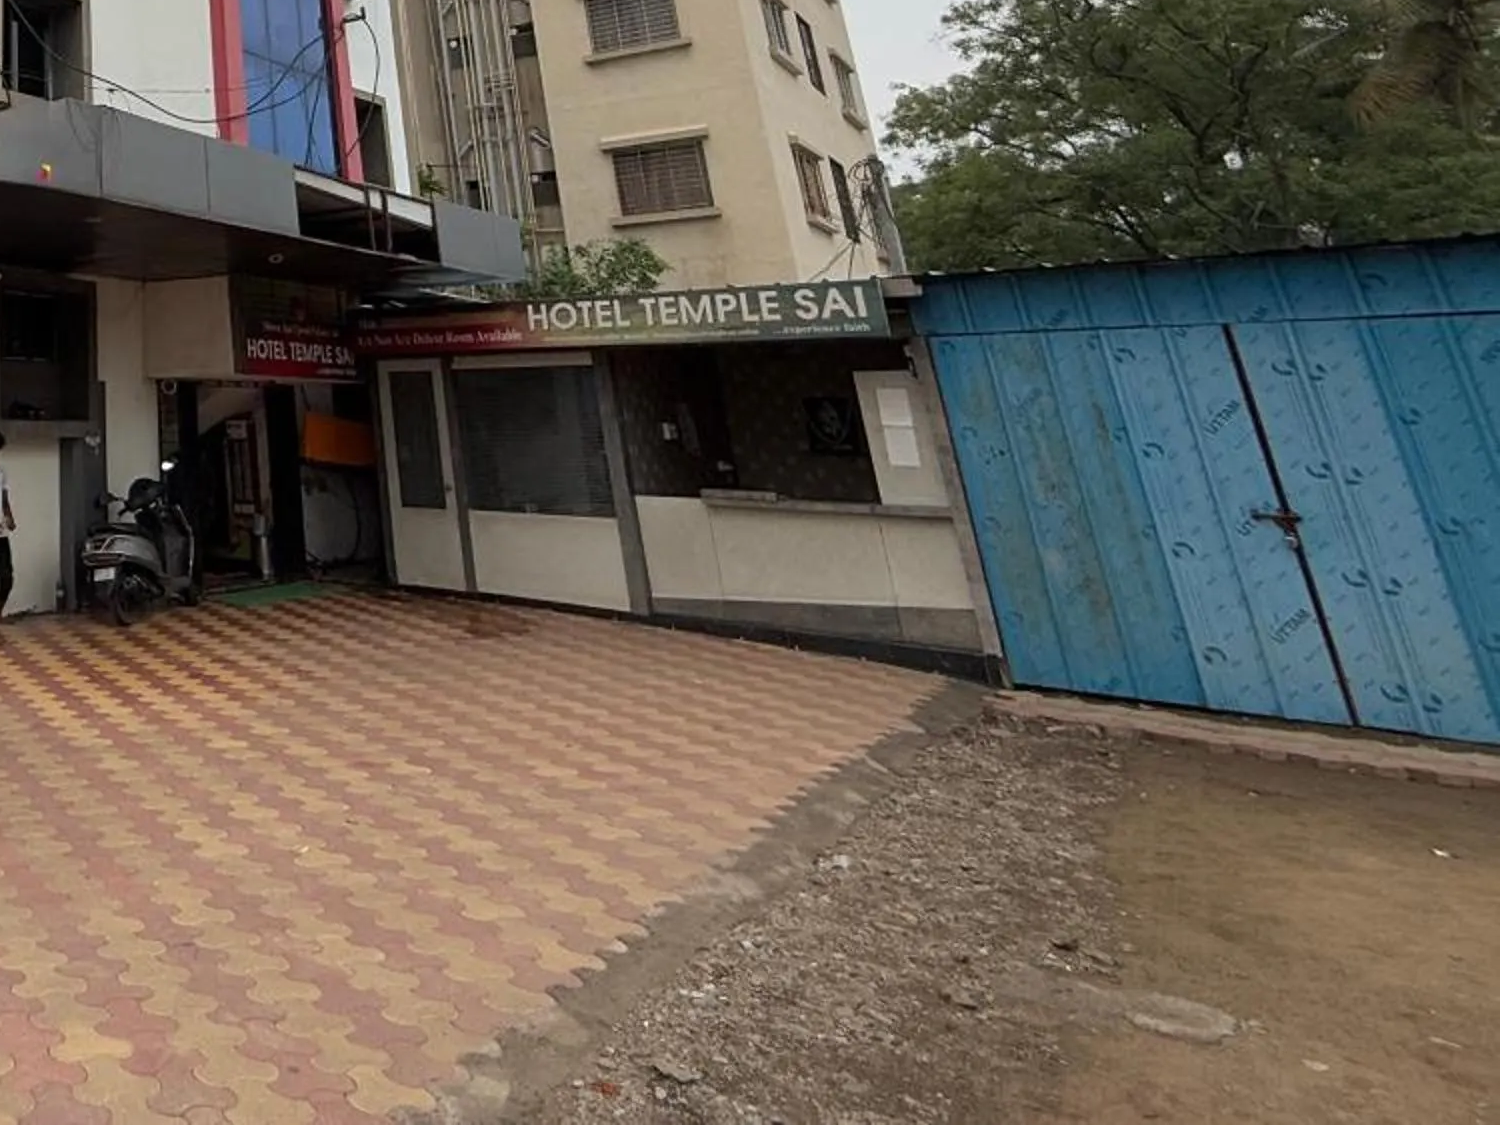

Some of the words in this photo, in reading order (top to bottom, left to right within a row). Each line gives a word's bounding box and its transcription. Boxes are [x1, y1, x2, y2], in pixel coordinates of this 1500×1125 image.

[527, 299, 631, 331] HOTEL
[638, 289, 782, 326] TEMPLE
[794, 286, 869, 321] SAI
[446, 330, 474, 344] Room
[475, 327, 523, 344] Available
[247, 338, 288, 361] HOTEL
[289, 341, 333, 364] TEMPLE
